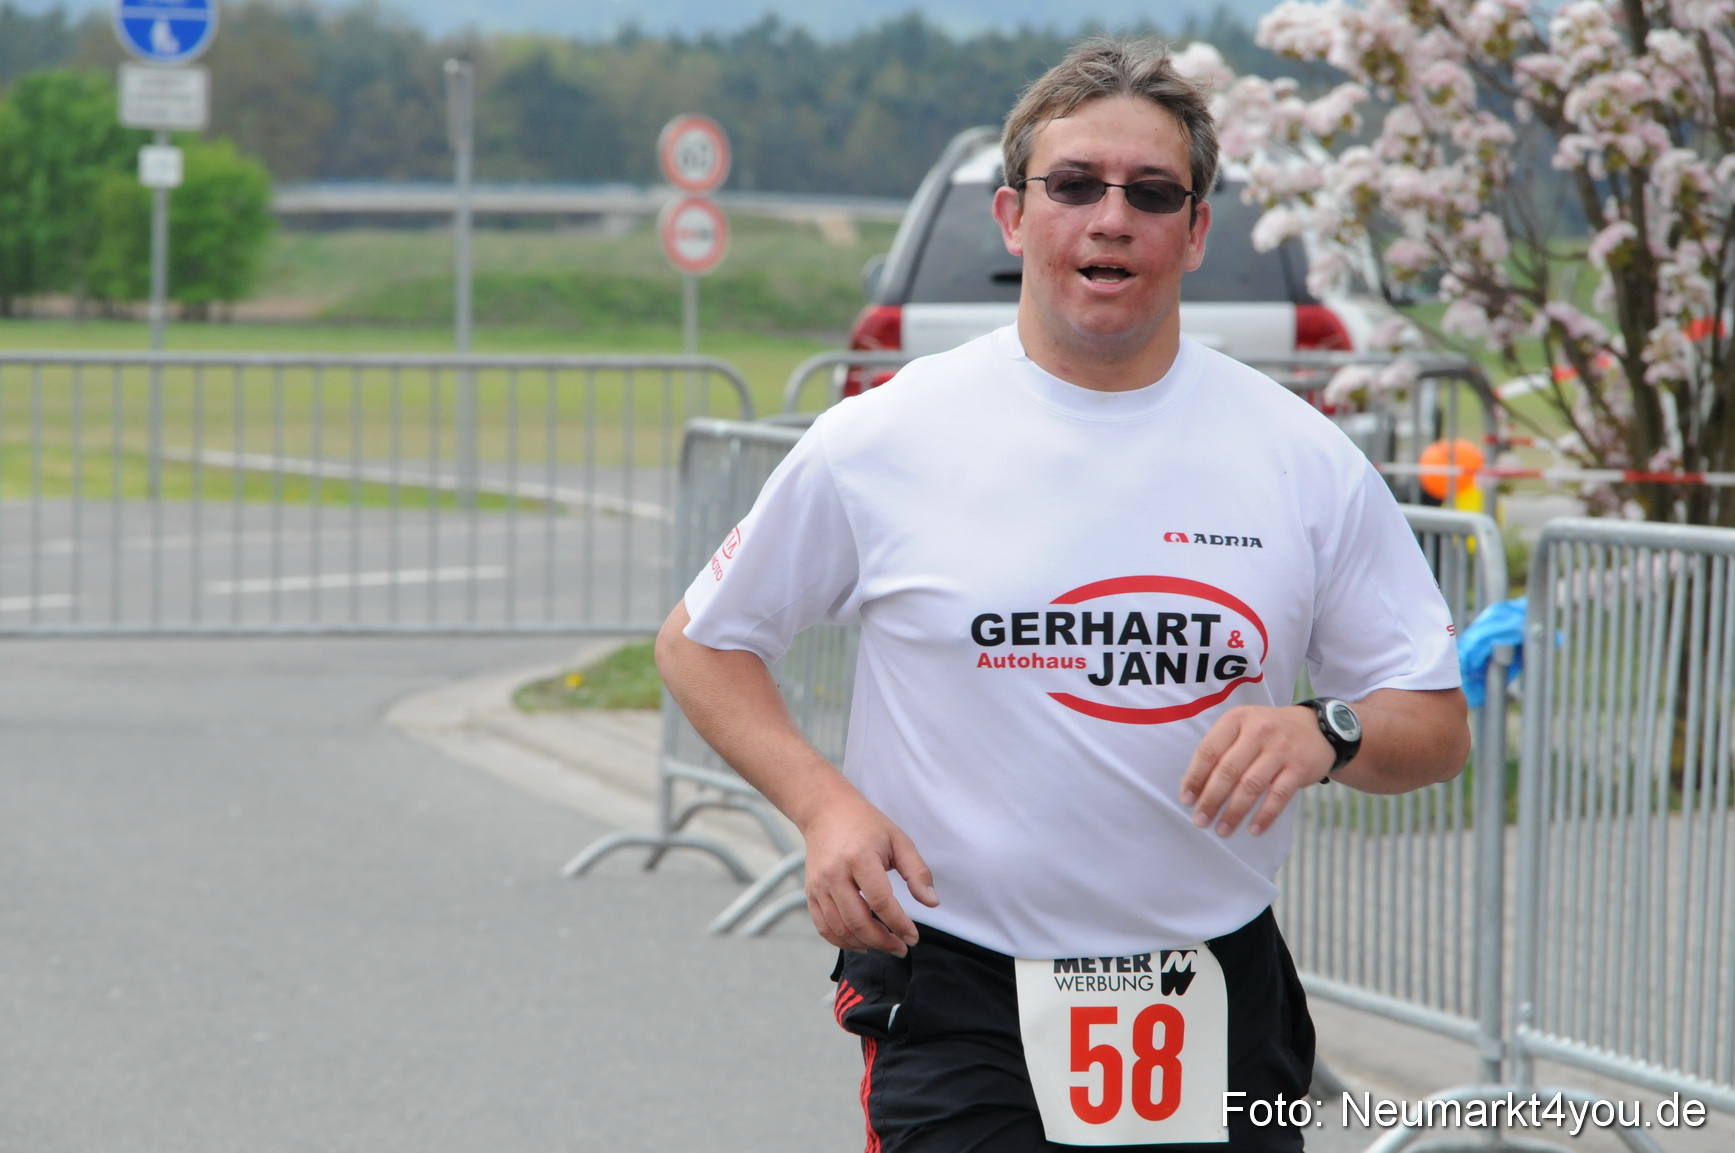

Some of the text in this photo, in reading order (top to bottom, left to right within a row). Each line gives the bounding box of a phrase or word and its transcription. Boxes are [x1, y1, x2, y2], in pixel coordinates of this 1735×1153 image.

[1193, 533, 1263, 548] ADRIA
[971, 611, 1245, 649] GERHART &
[977, 651, 1248, 687] Autohaus JÄNIG
[1053, 953, 1153, 974] MEYER
[1054, 975, 1154, 992] WERBUNG
[1069, 1003, 1185, 1125] 58
